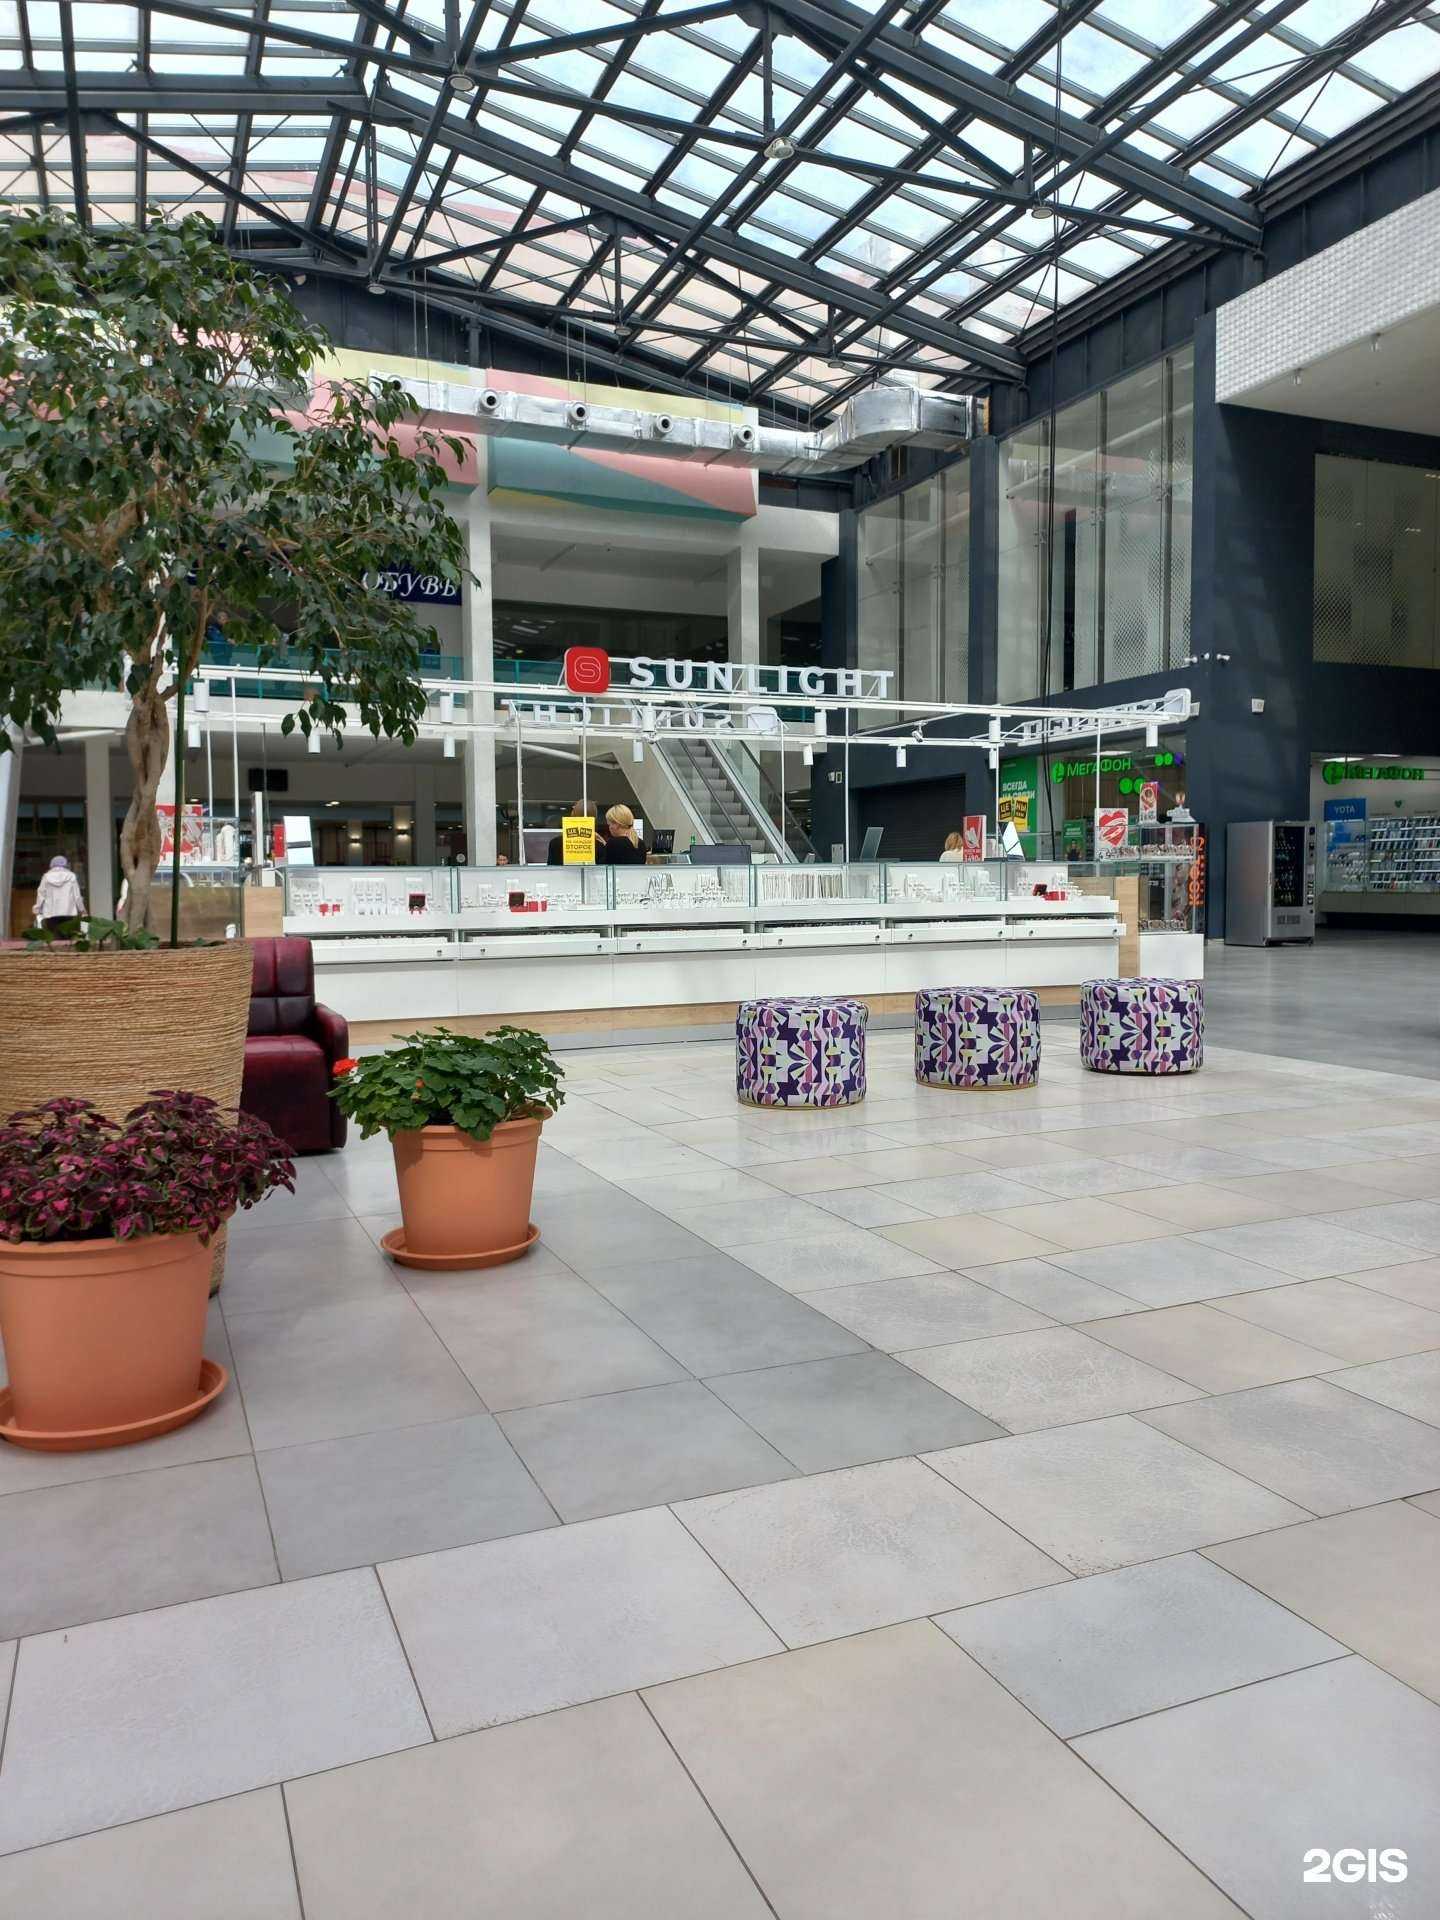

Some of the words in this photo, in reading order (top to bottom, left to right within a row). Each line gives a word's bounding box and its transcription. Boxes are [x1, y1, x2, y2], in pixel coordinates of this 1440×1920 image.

[362, 571, 458, 597] ОБУВЬ
[629, 656, 894, 698] SUNLIGHT
[1067, 758, 1131, 776] МЕГАФОН
[1002, 780, 1027, 791] ВСЕГДА
[1333, 805, 1356, 814] YOTA
